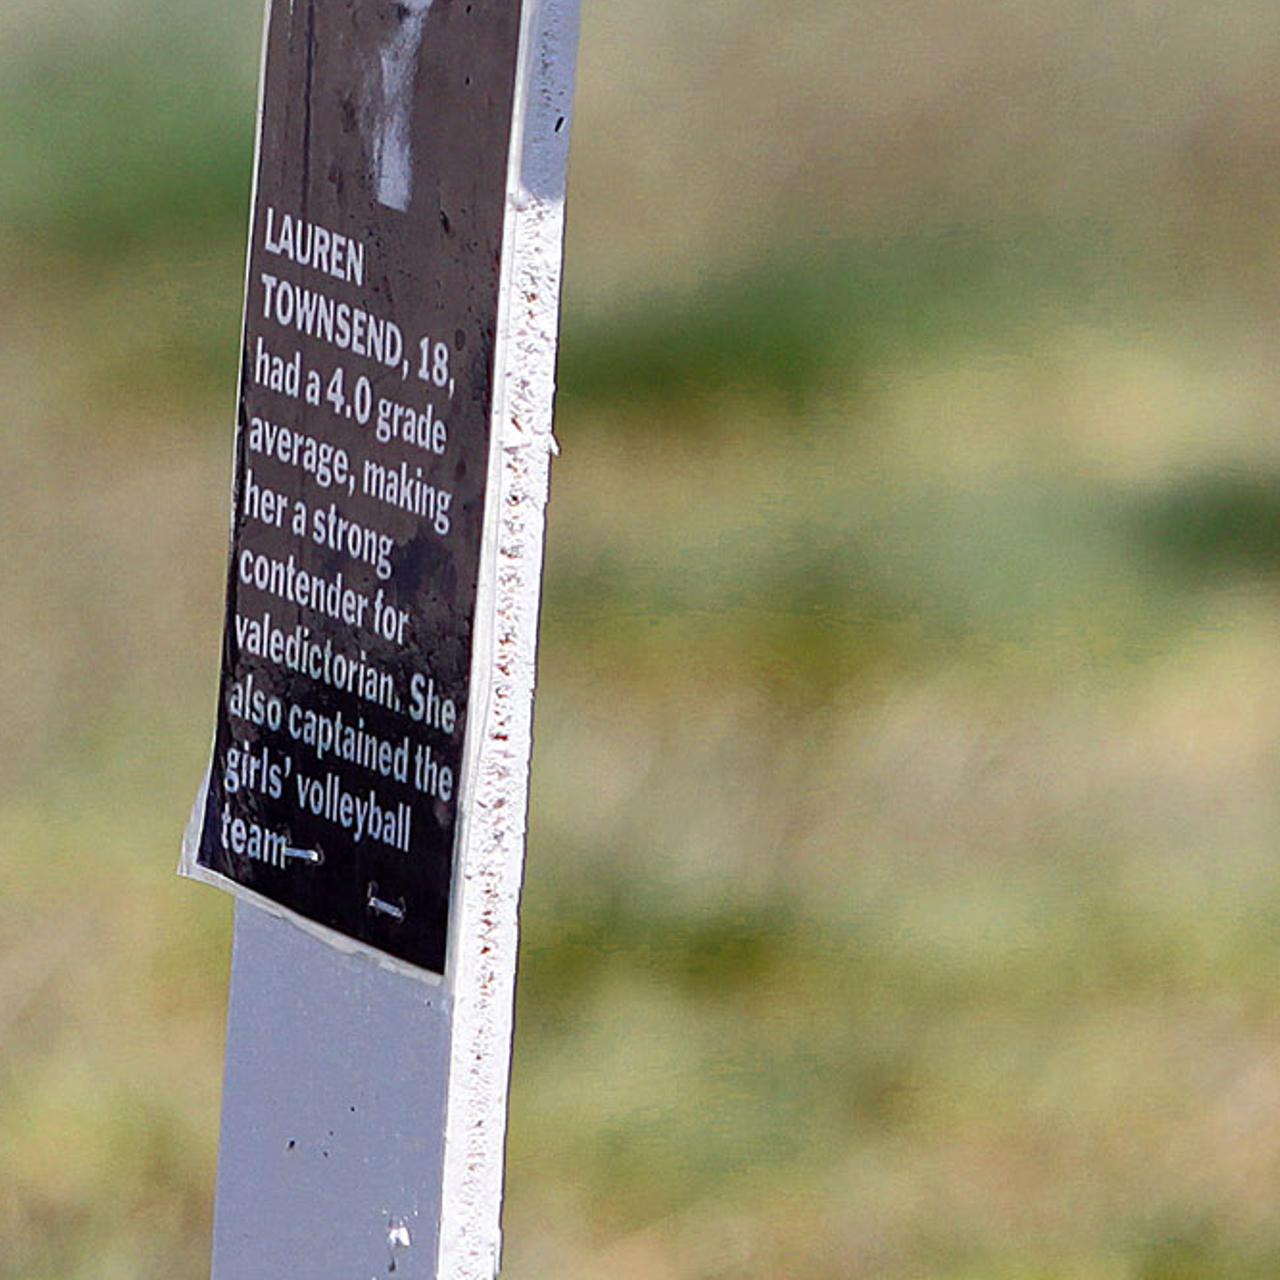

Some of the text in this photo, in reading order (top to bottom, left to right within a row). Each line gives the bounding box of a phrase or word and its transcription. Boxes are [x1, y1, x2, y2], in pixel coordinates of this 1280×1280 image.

[265, 207, 364, 286] LAUREN
[261, 273, 455, 398] TOWNSEND, 18,
[255, 337, 447, 455] had a 4.0 grade
[244, 469, 394, 580] her a strong
[249, 416, 453, 536] average, making
[239, 548, 410, 646] contender for
[234, 612, 457, 735] valedictorian. She
[222, 741, 412, 853] girls' volleyball
[229, 675, 453, 802] also captained the
